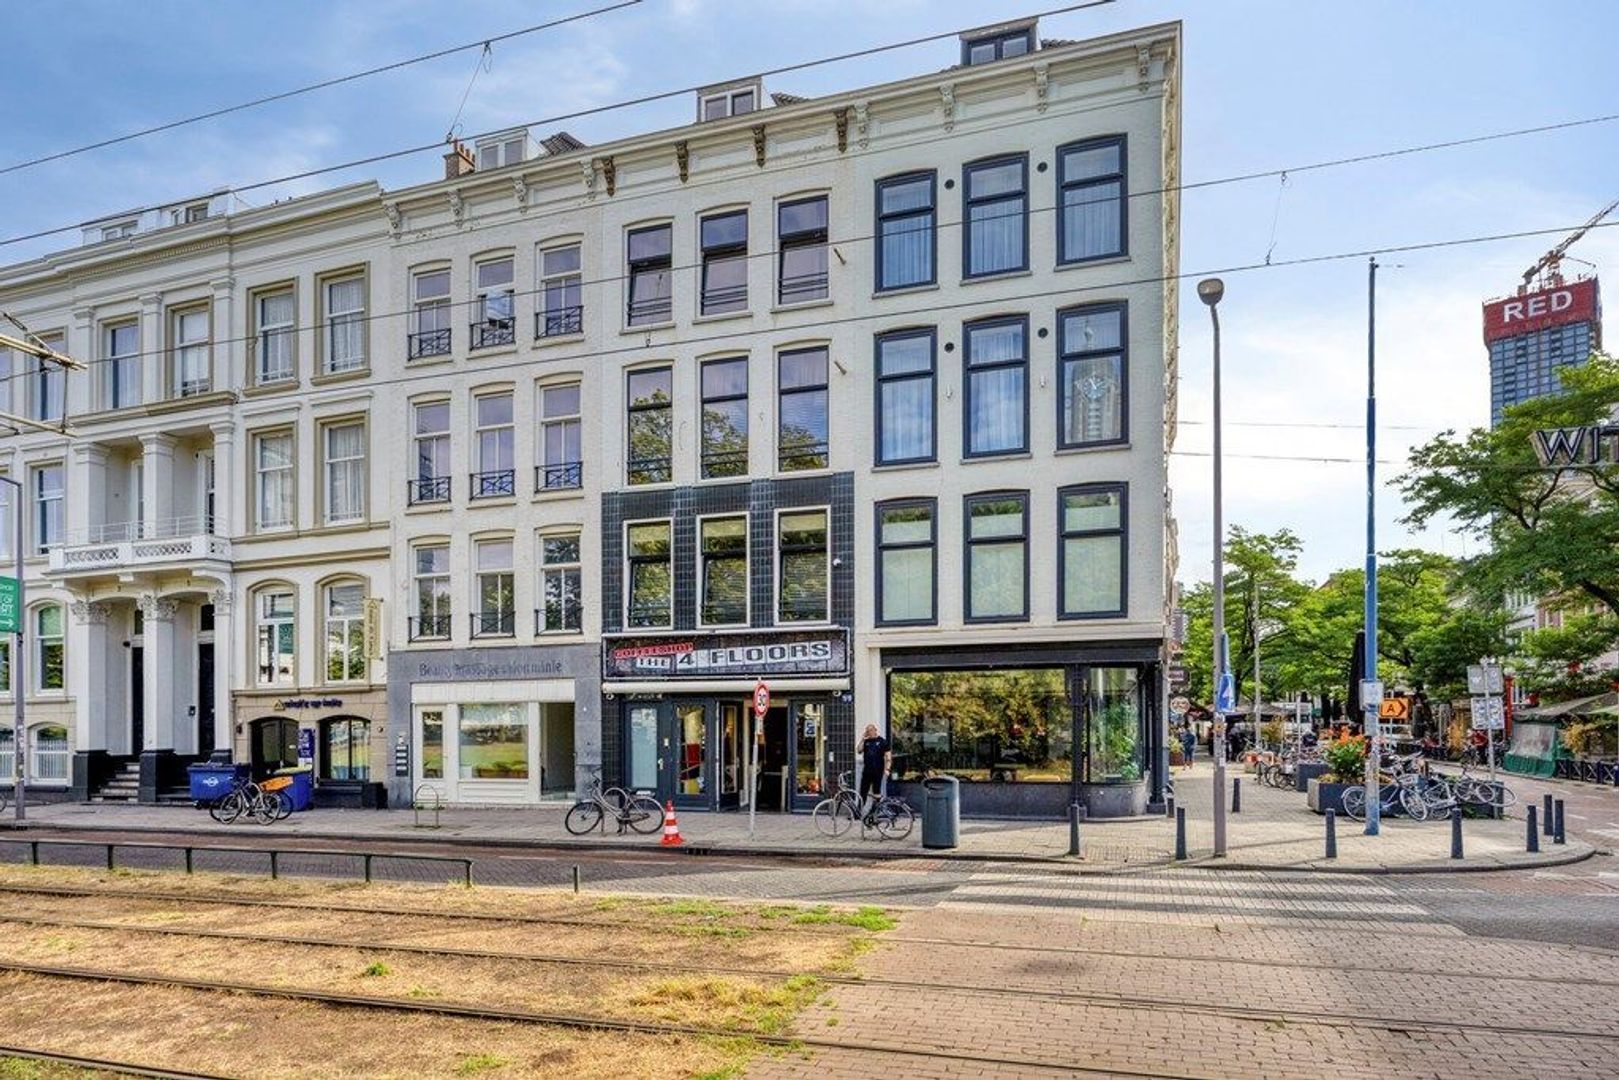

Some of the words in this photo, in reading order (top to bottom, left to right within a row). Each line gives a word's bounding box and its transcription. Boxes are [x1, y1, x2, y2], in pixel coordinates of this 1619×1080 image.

[1503, 290, 1573, 323] RED
[678, 653, 694, 666] 4
[711, 643, 830, 664] FLOORS
[1386, 703, 1396, 713] A
